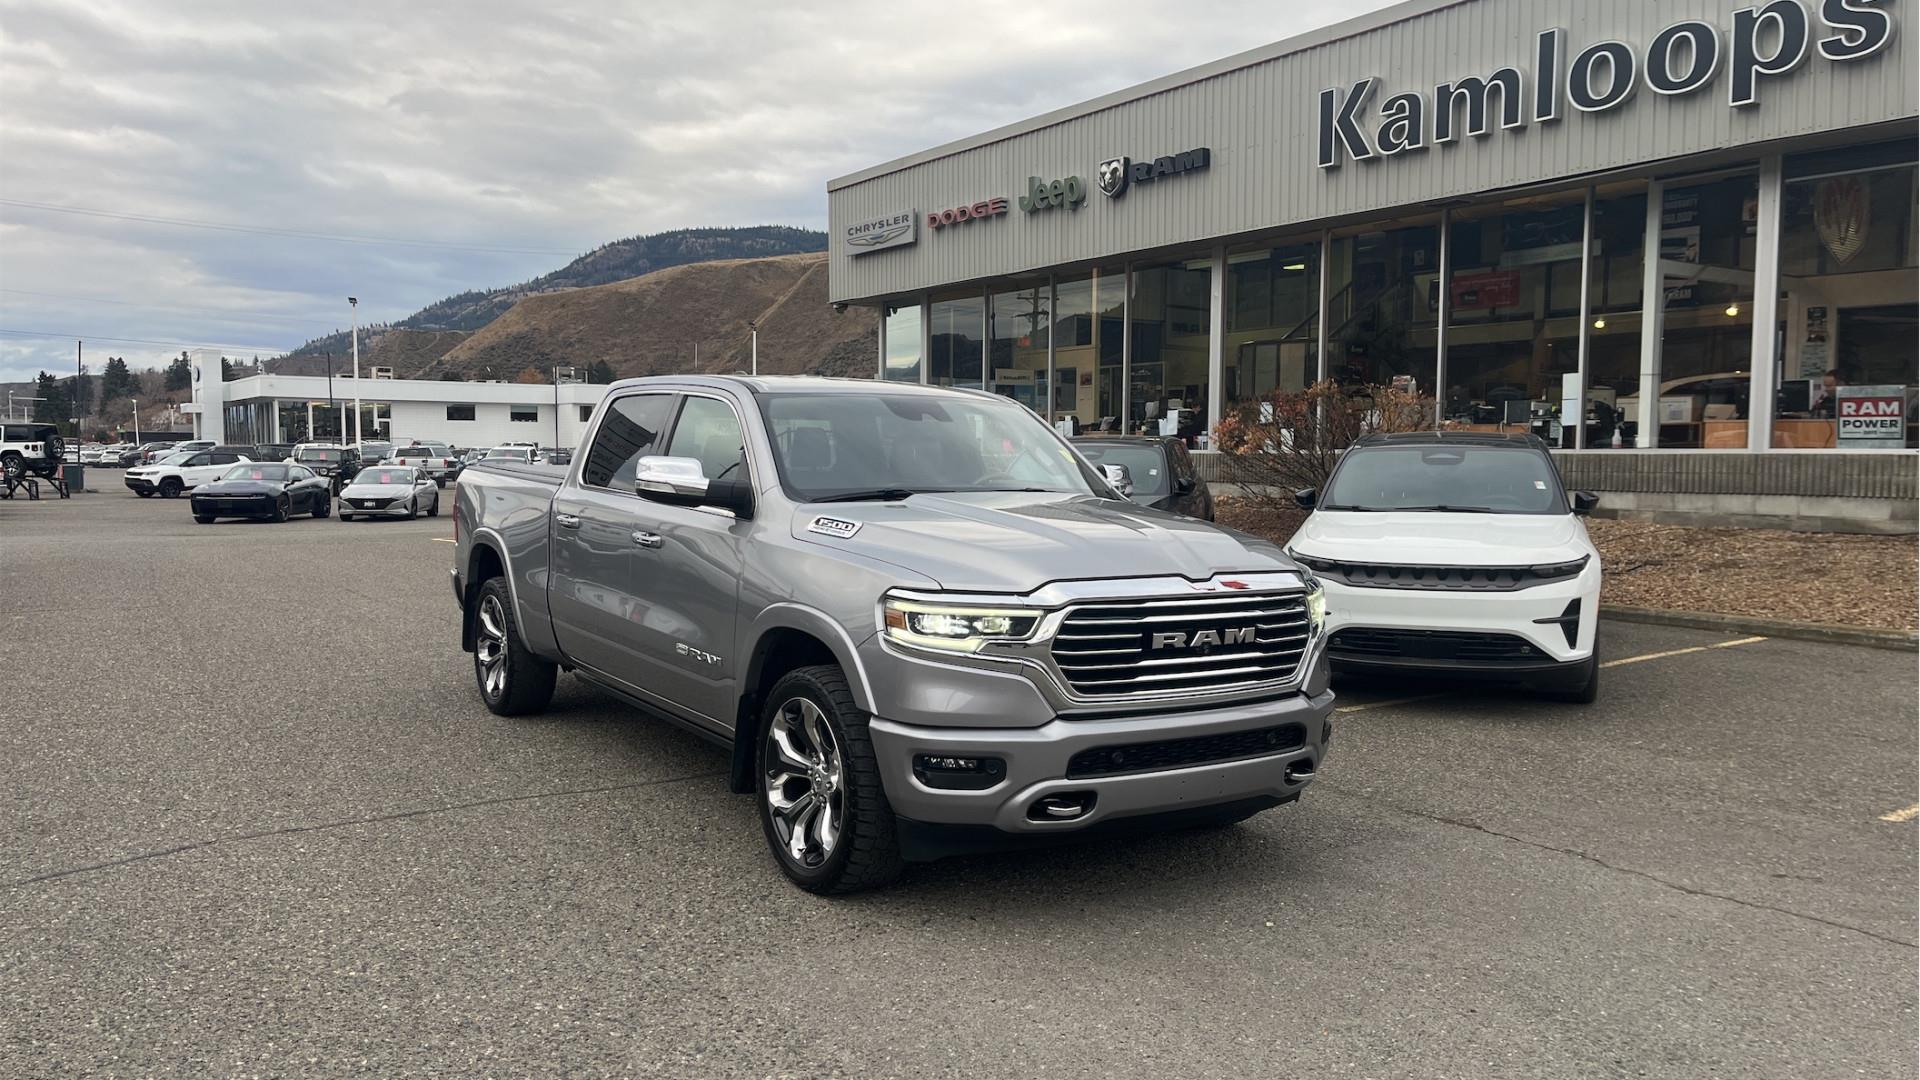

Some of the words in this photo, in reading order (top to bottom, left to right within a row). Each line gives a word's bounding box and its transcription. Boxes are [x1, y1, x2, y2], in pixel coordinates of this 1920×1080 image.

[1318, 0, 1892, 168] Kamloops
[1129, 147, 1211, 183] RAM
[1018, 175, 1087, 213] Jeep
[847, 213, 910, 236] CHRYSLER
[928, 197, 1008, 229] DODGE
[1842, 401, 1900, 416] RAM
[1842, 419, 1898, 429] POWER
[817, 518, 853, 531] 1500
[1152, 627, 1256, 650] RAM
